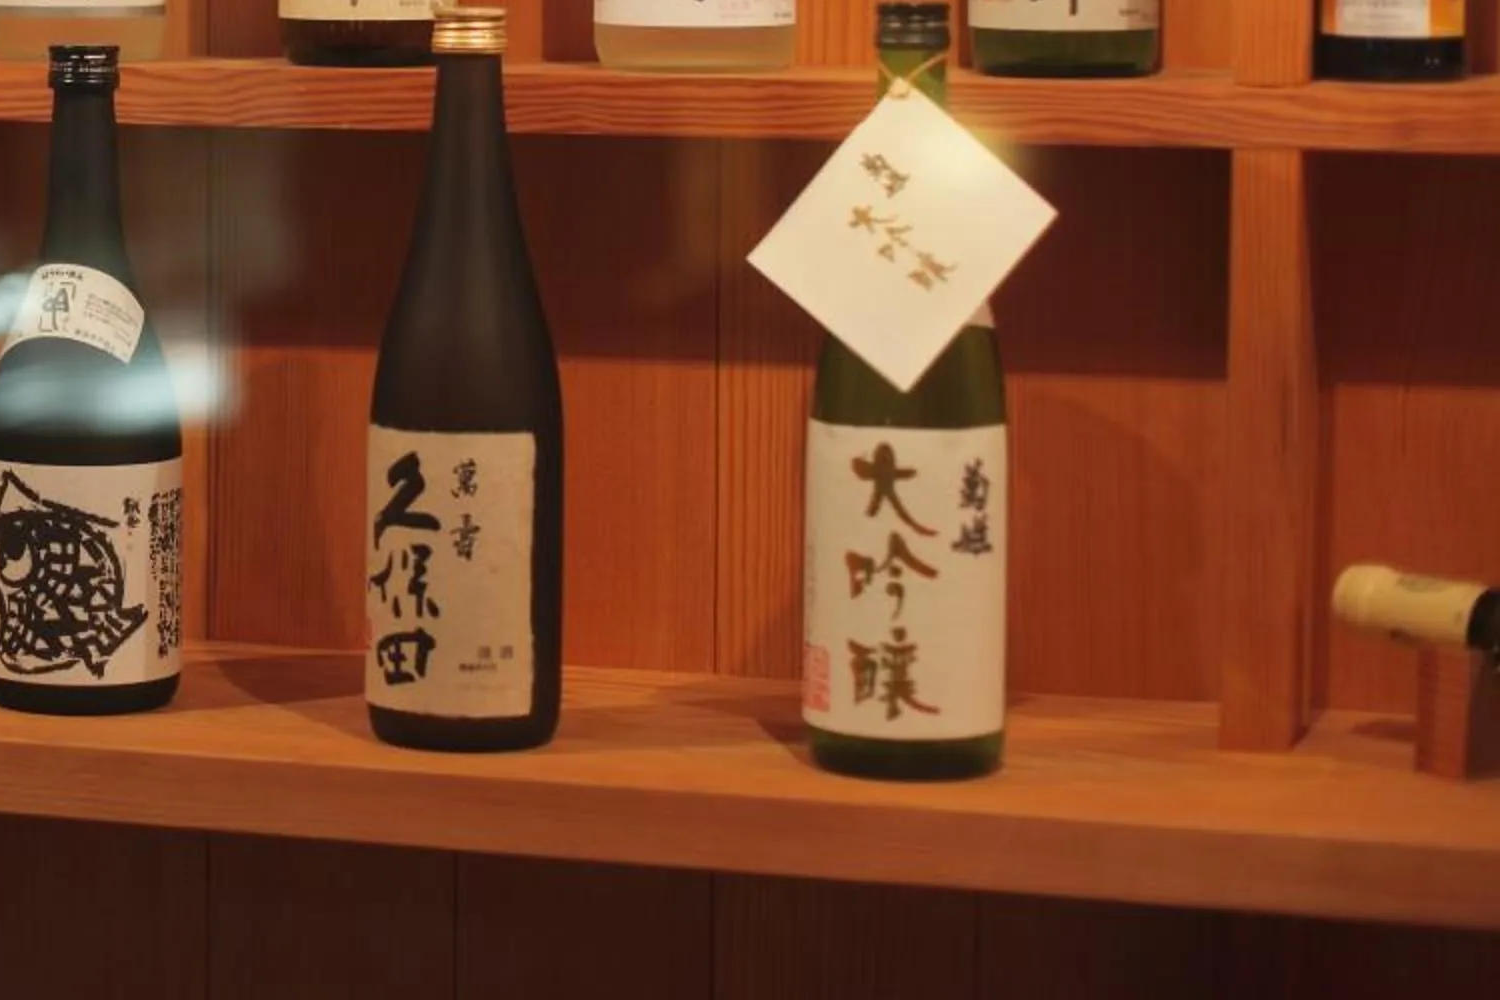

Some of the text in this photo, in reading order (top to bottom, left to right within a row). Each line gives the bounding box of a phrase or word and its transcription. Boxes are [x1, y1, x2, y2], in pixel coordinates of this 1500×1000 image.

[368, 451, 442, 687] 久保田
[844, 441, 940, 722] 大吟醸
